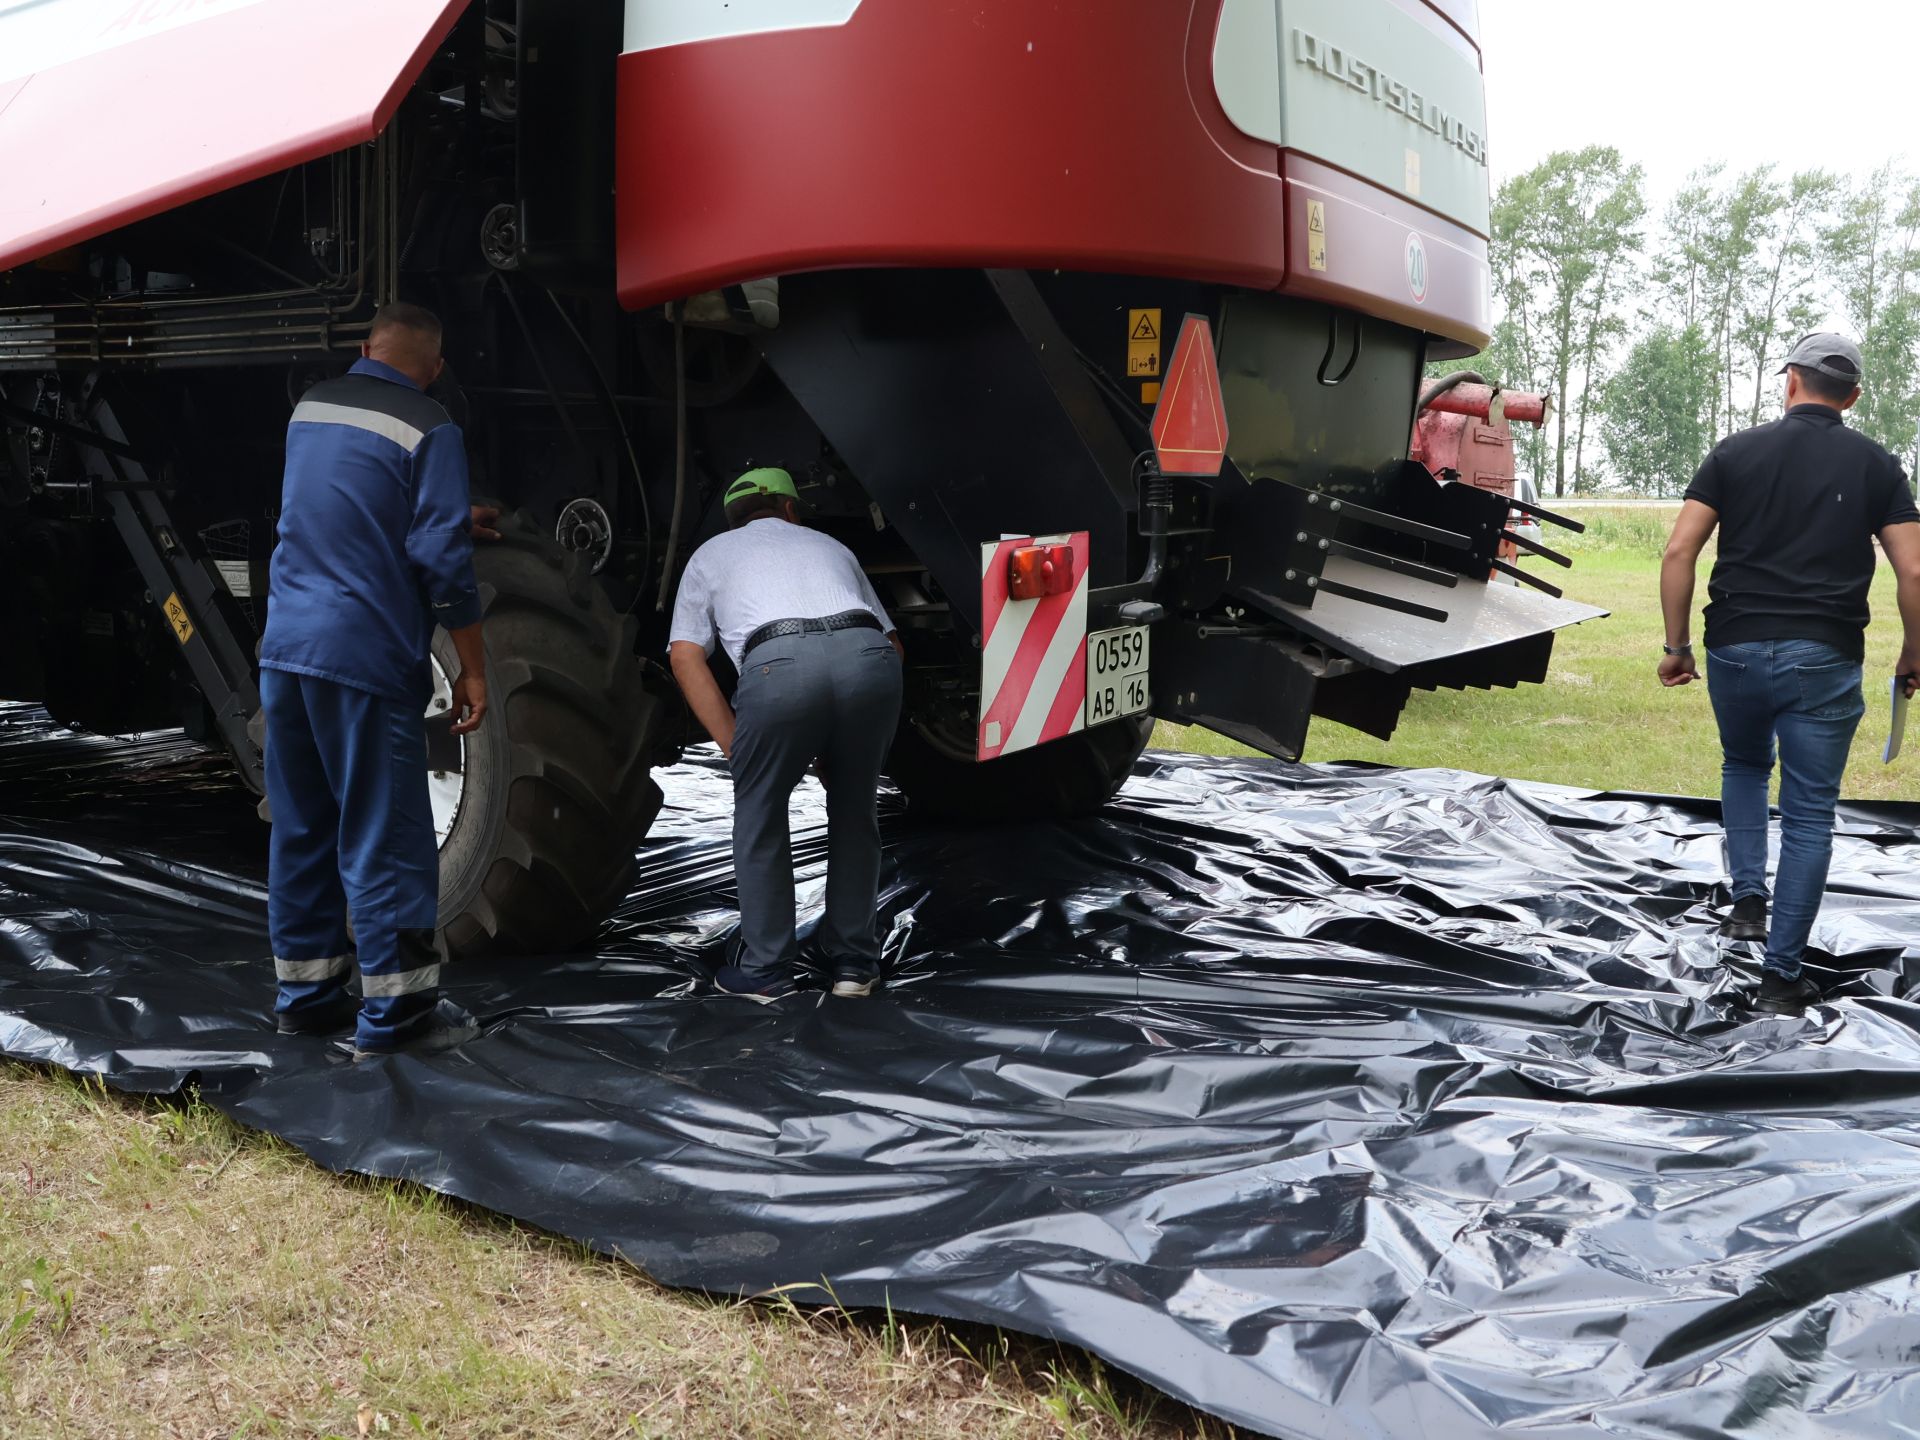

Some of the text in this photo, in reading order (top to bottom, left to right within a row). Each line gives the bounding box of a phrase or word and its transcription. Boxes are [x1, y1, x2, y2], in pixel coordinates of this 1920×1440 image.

[1293, 27, 1487, 167] ROSTSELMASH
[1409, 245, 1424, 288] 20
[1096, 631, 1143, 674] 0559
[1092, 680, 1144, 719] AB 16
